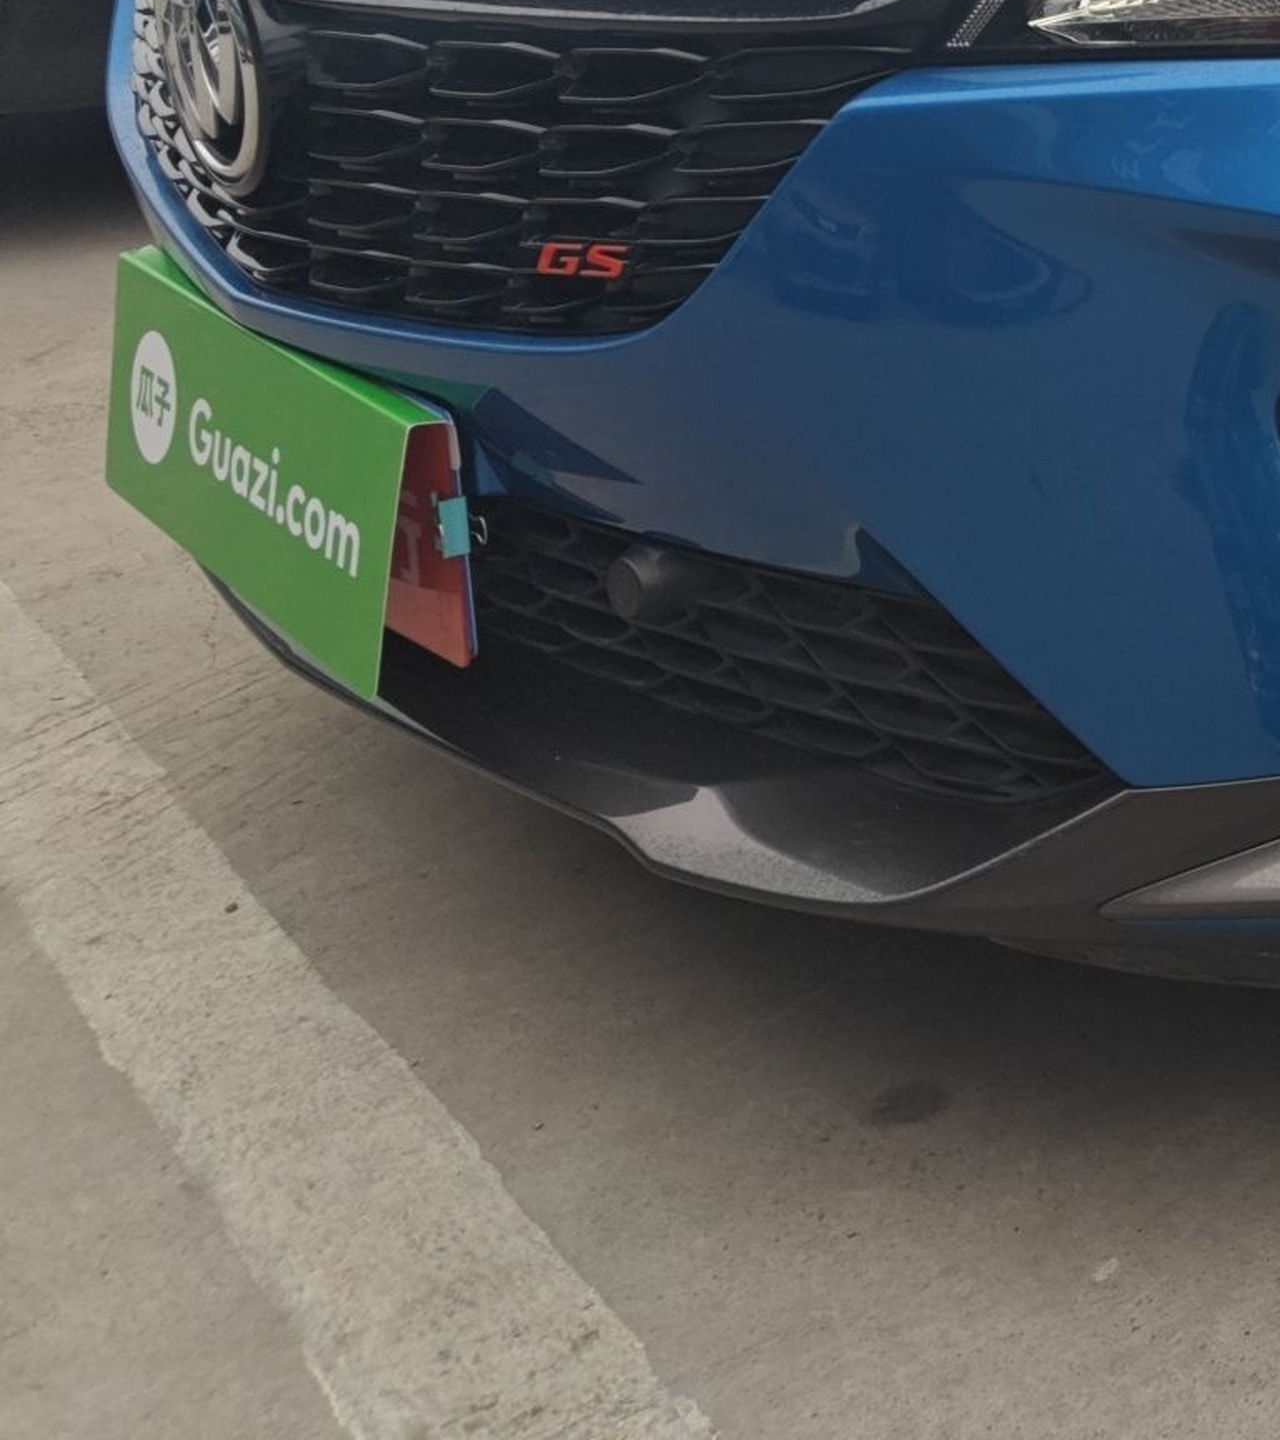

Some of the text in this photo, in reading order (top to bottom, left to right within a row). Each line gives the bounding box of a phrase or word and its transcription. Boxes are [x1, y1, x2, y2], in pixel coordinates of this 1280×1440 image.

[537, 242, 627, 278] GS
[136, 364, 171, 427] 瓜子
[188, 397, 361, 579] Guazi.com
